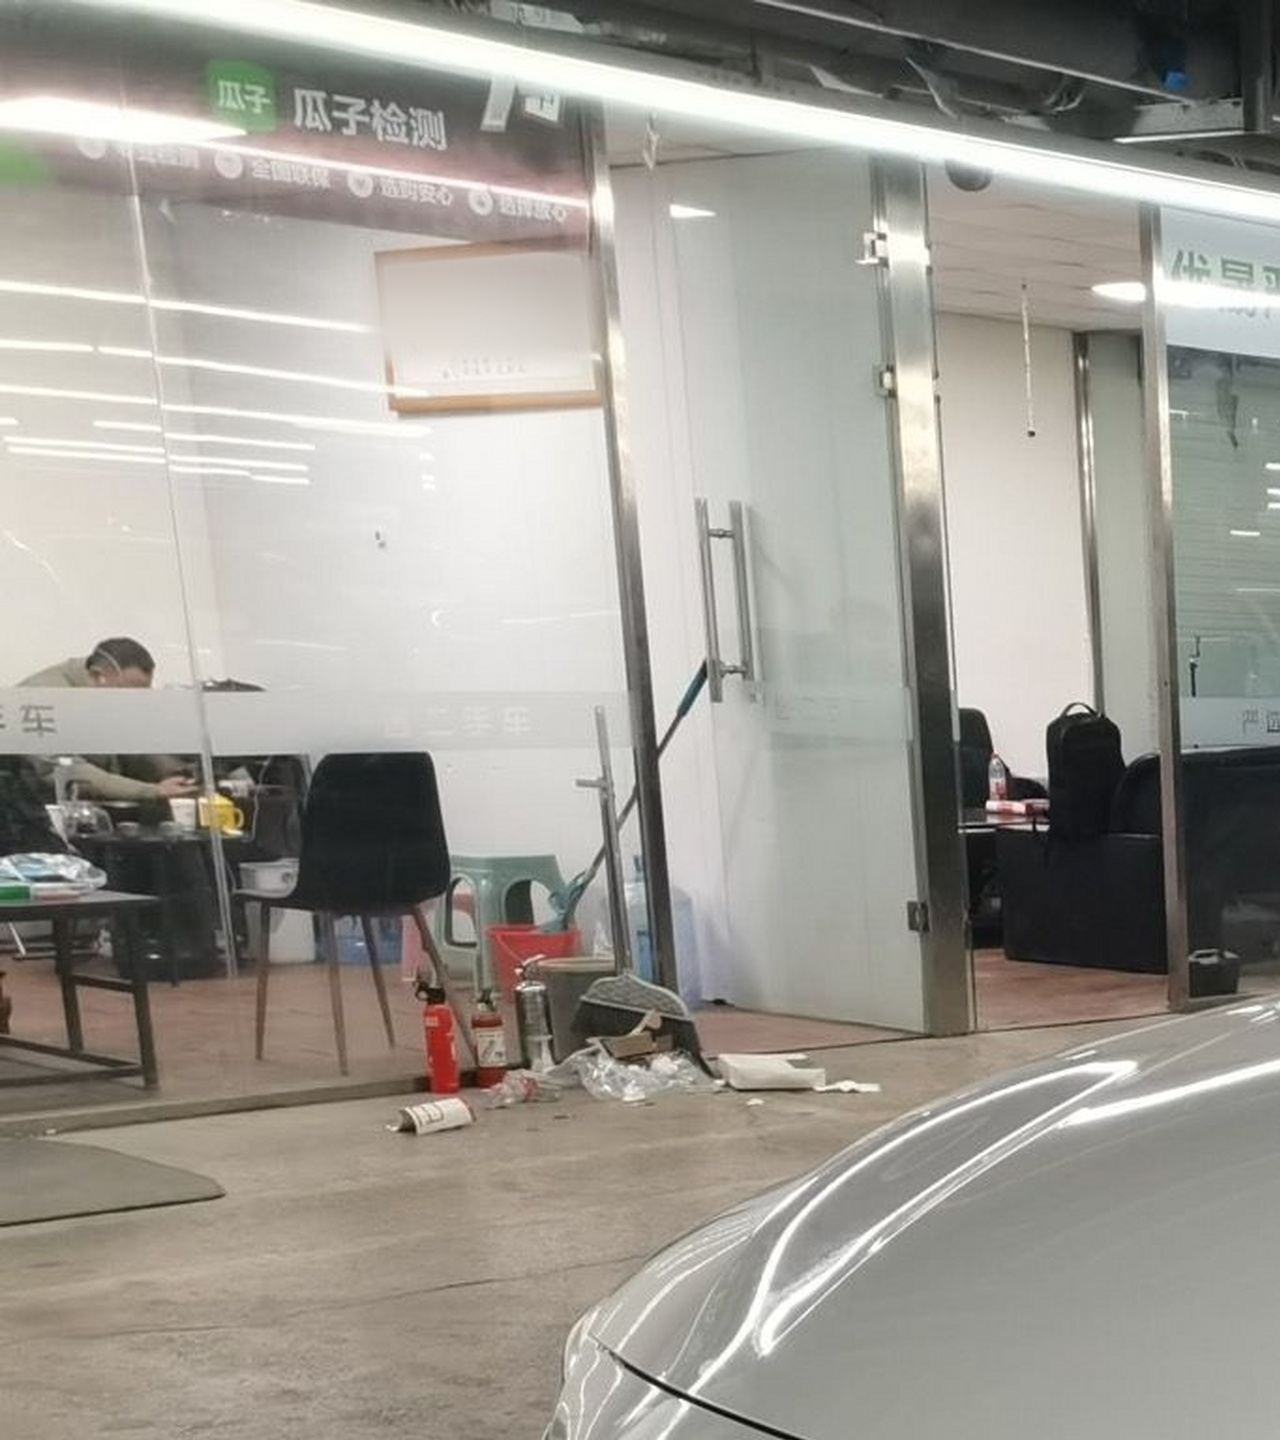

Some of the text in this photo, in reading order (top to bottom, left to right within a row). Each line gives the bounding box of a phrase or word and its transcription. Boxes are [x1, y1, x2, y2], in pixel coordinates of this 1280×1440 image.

[217, 79, 270, 114] 瓜子
[293, 86, 448, 151] 瓜子检测
[0, 704, 58, 738] 车
